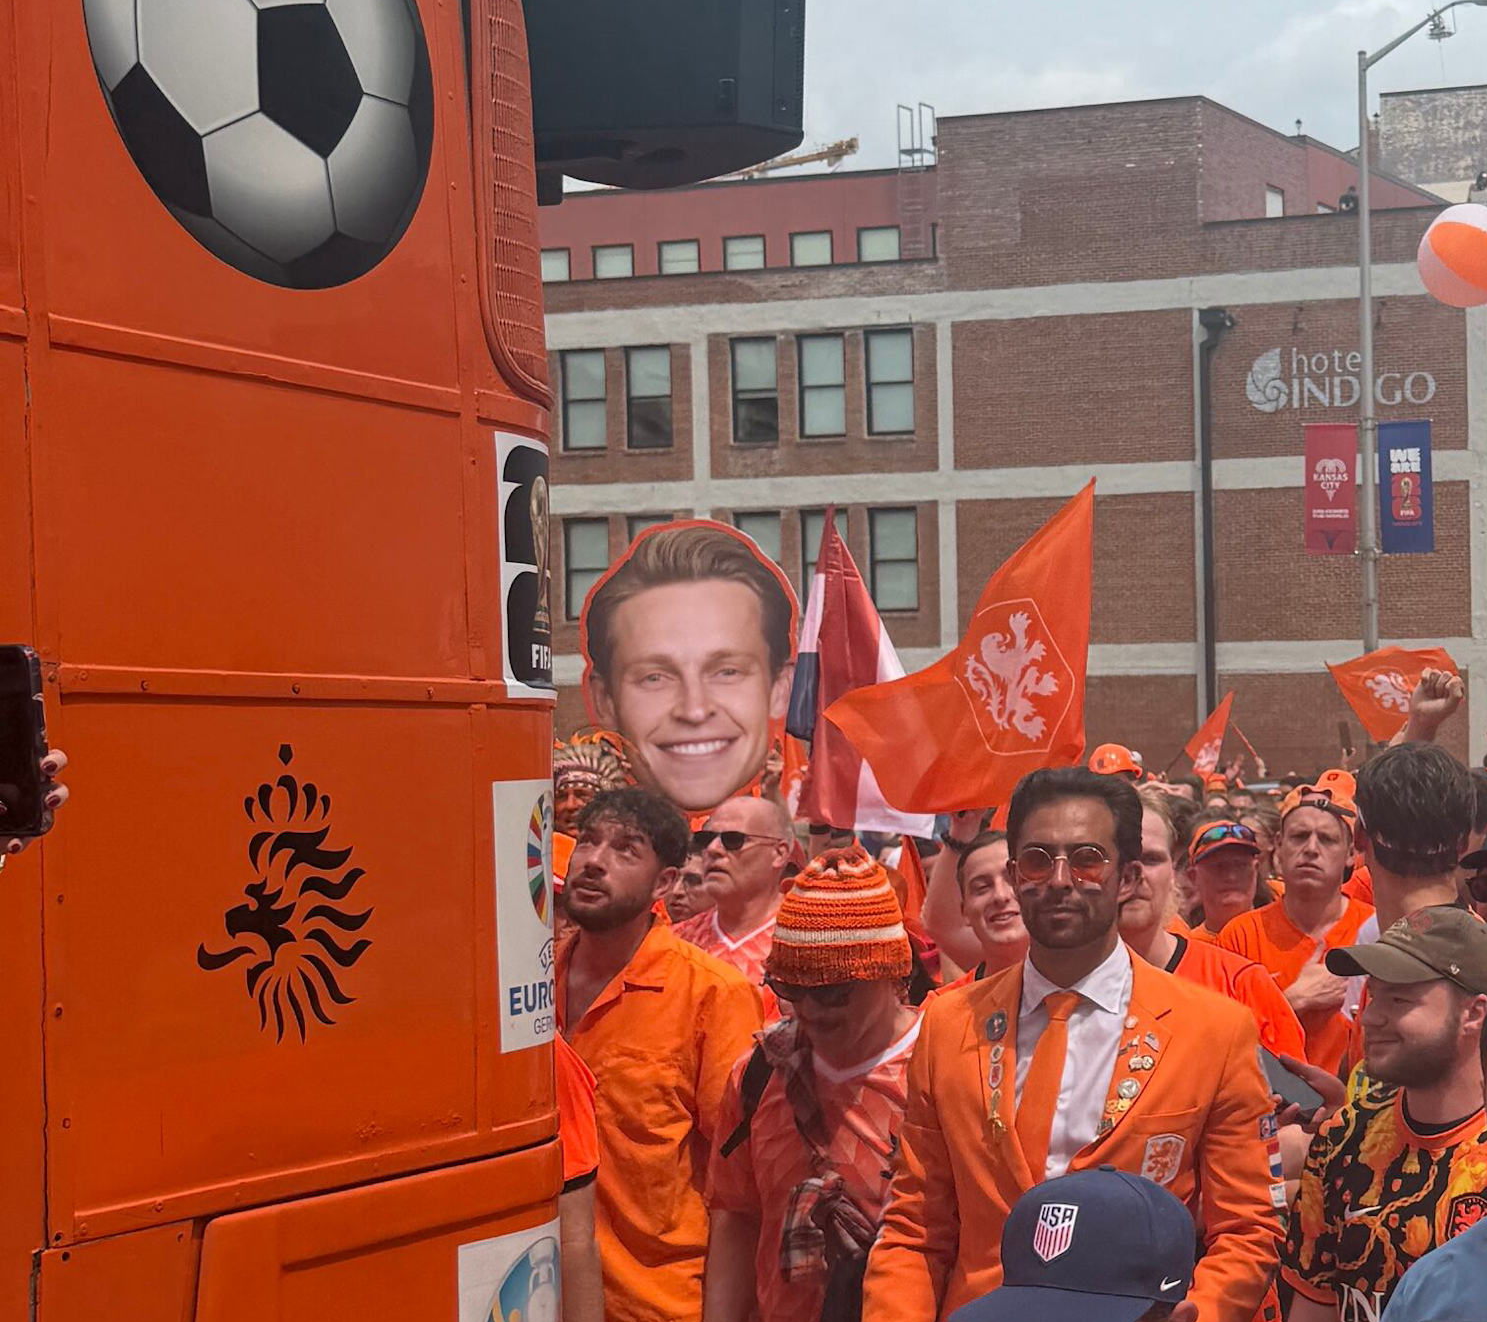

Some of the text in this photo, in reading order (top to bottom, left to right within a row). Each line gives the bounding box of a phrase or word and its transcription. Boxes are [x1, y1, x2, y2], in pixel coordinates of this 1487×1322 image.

[1292, 347, 1363, 374] hote
[1292, 371, 1437, 409] INDGO
[1389, 447, 1421, 462] WE
[1313, 473, 1348, 481] KANSAS
[1320, 481, 1341, 489] CITY
[1400, 509, 1416, 517] FIFA
[1041, 1206, 1075, 1228] USA
